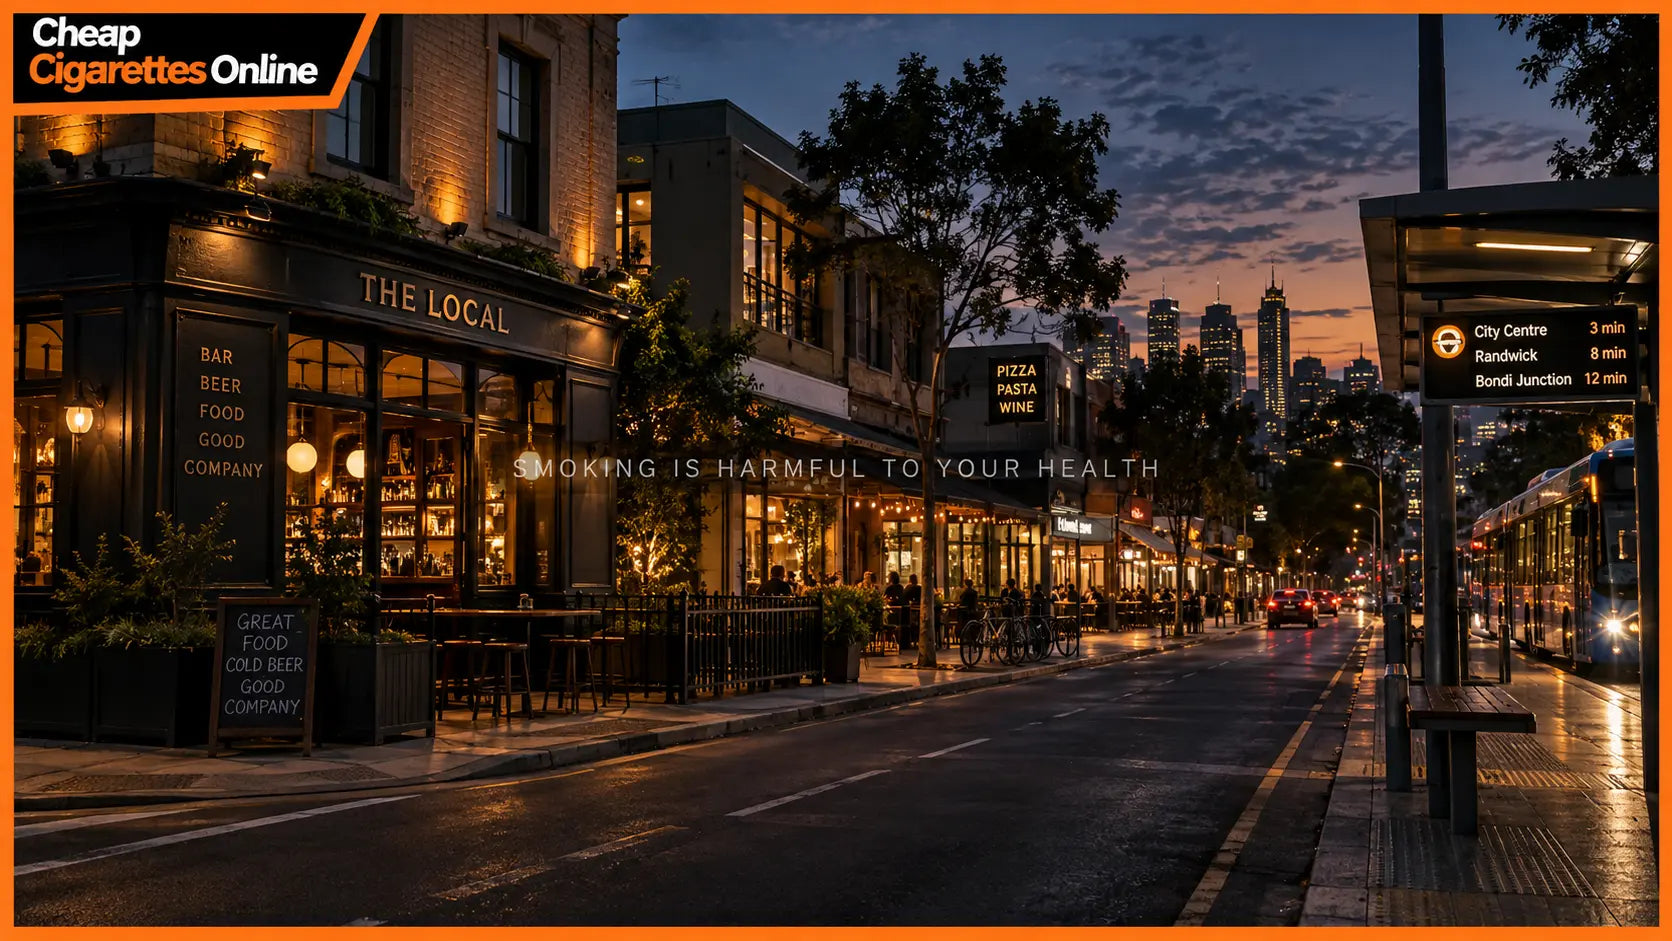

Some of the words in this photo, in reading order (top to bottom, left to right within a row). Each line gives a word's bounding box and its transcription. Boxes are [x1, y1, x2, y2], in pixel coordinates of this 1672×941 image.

[360, 272, 416, 312] THE
[427, 289, 510, 335] LOCAL
[1475, 325, 1500, 340] City
[1504, 324, 1547, 337] Centre
[1590, 322, 1598, 334] 3
[1601, 321, 1625, 334] min
[201, 347, 232, 364] BAR
[1475, 349, 1538, 363] Randwick
[1590, 347, 1599, 360] 8
[1602, 347, 1626, 359] min
[997, 364, 1036, 377] PIZZA
[201, 375, 241, 393] BEER
[1476, 374, 1513, 387] Bondi
[1516, 373, 1572, 386] Junction
[1584, 372, 1600, 385] 12
[1603, 372, 1627, 384] min
[997, 382, 1037, 395] PASTA
[200, 404, 244, 421] FOOD
[1000, 401, 1034, 414] WINE
[199, 432, 245, 449] GOOD
[184, 460, 263, 478] COMPANY
[237, 613, 294, 629] GREAT
[243, 635, 288, 651] FOOD
[226, 657, 262, 672] COLD
[268, 657, 303, 672] BEER
[241, 679, 284, 694] GOOD
[225, 699, 300, 714] COMPANY
